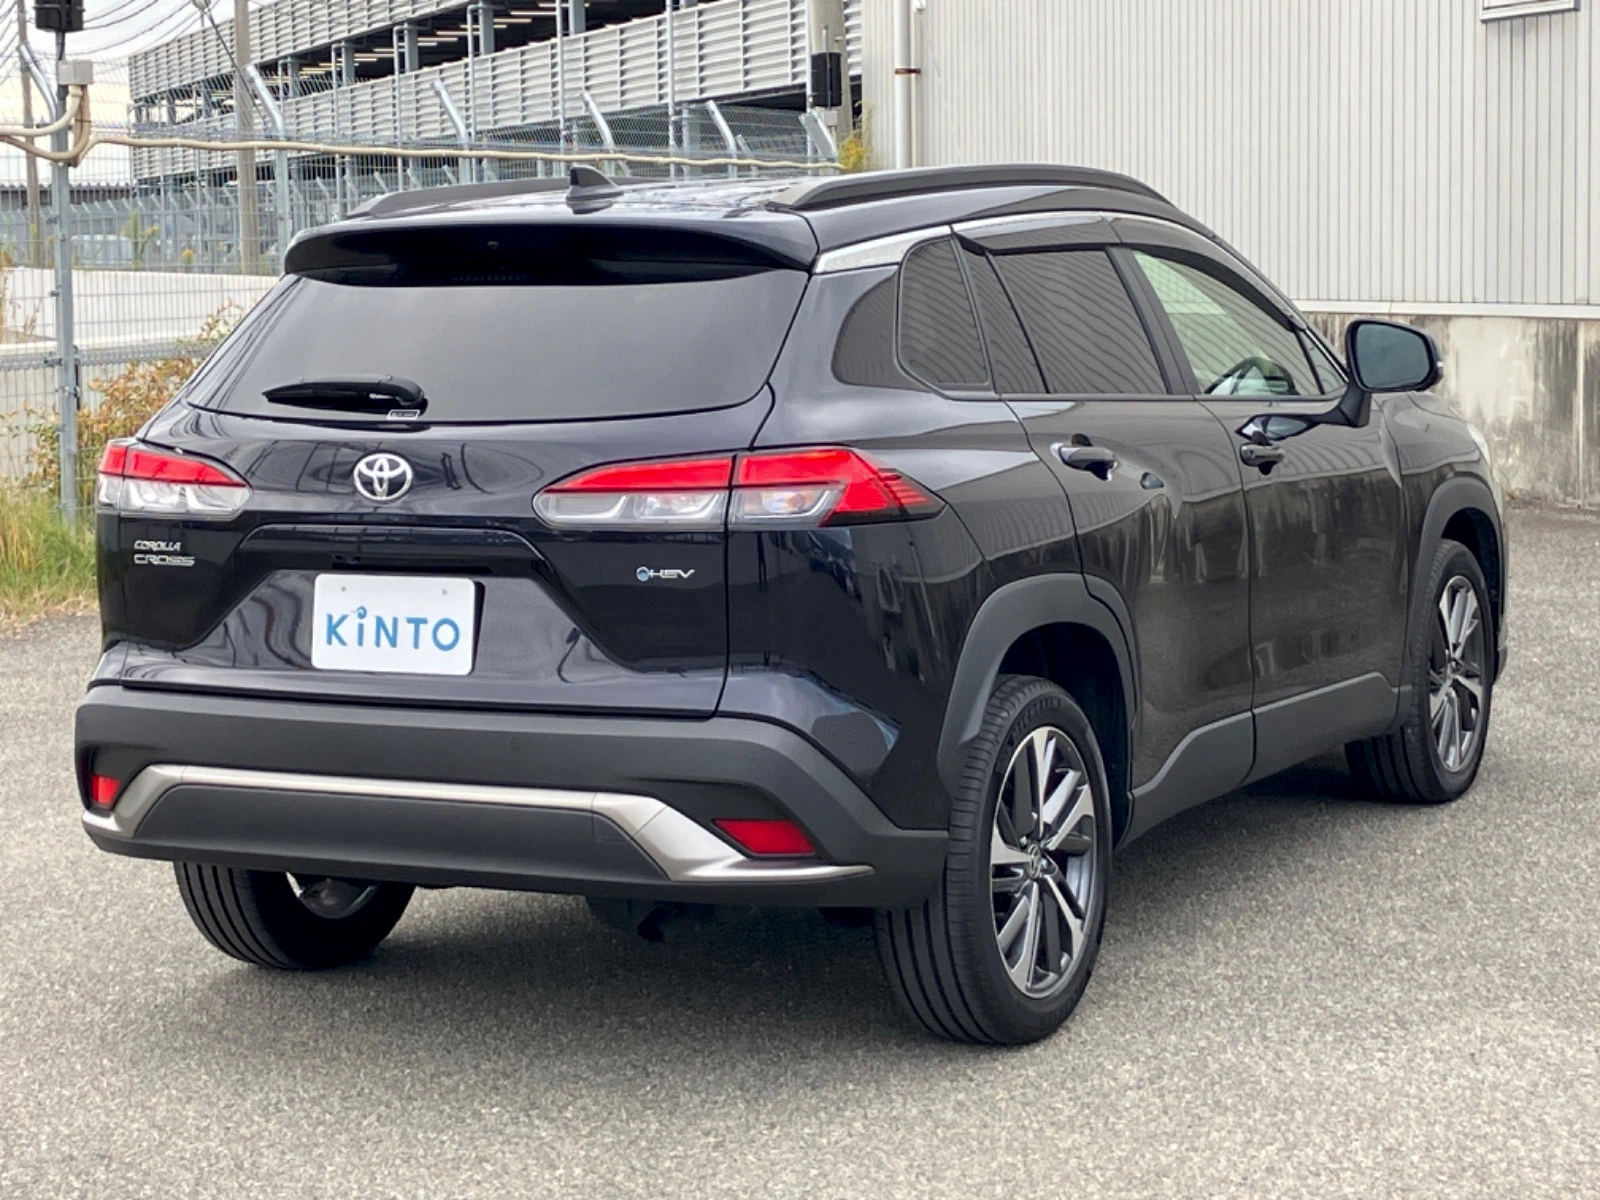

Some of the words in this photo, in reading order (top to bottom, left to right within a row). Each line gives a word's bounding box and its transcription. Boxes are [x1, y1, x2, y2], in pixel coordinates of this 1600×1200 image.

[133, 540, 181, 551] COROLLA
[133, 553, 196, 567] CROSS
[649, 569, 695, 579] HEV
